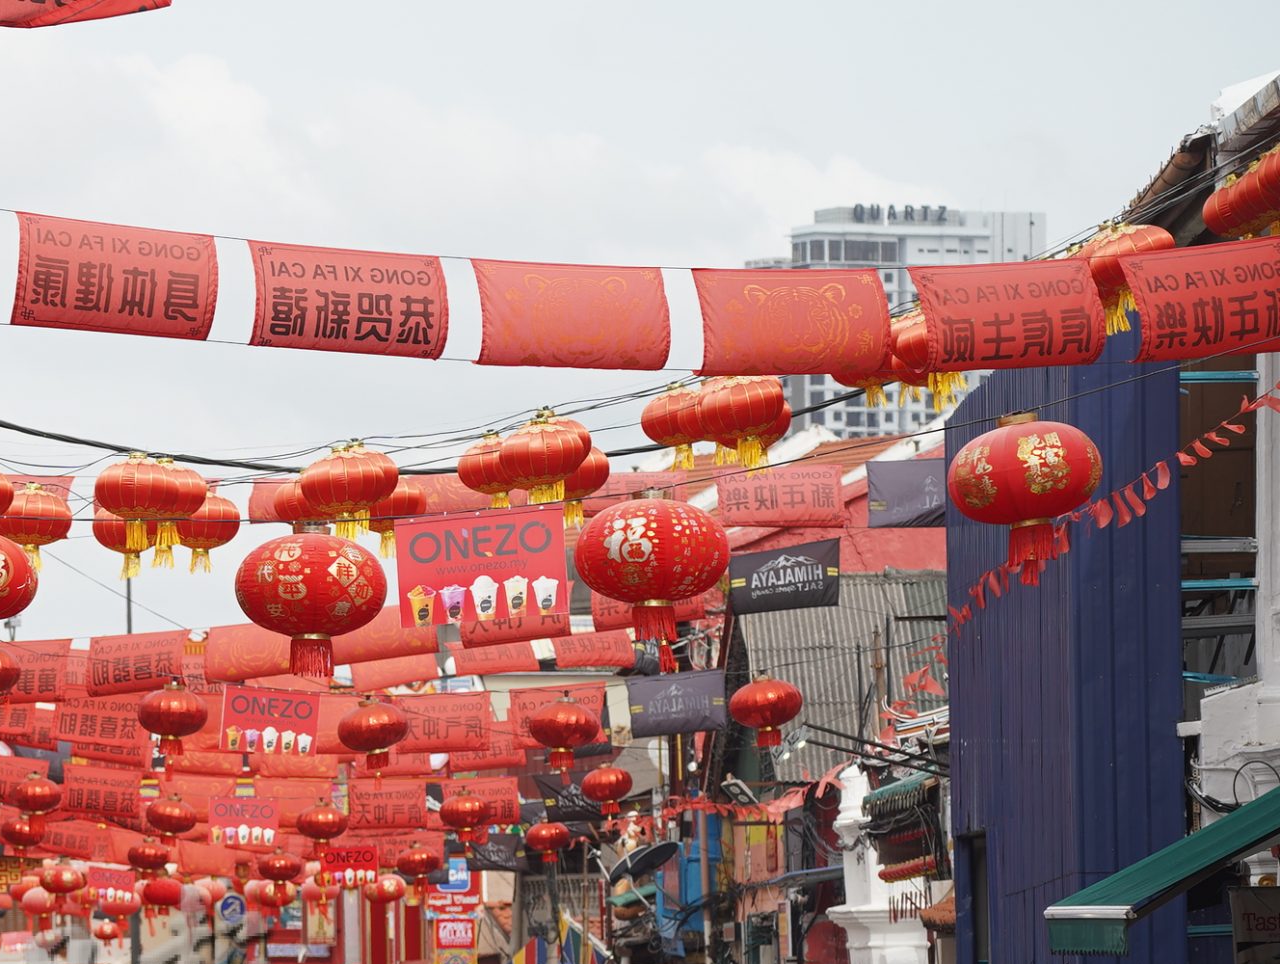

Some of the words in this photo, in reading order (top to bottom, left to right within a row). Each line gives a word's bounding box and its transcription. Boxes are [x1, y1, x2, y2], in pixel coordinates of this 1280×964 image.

[853, 204, 948, 223] QUARTZ
[409, 520, 552, 564] ONEZO
[230, 695, 313, 720] ONEZO
[214, 803, 274, 819] ONEZO
[324, 850, 374, 865] ONEZO
